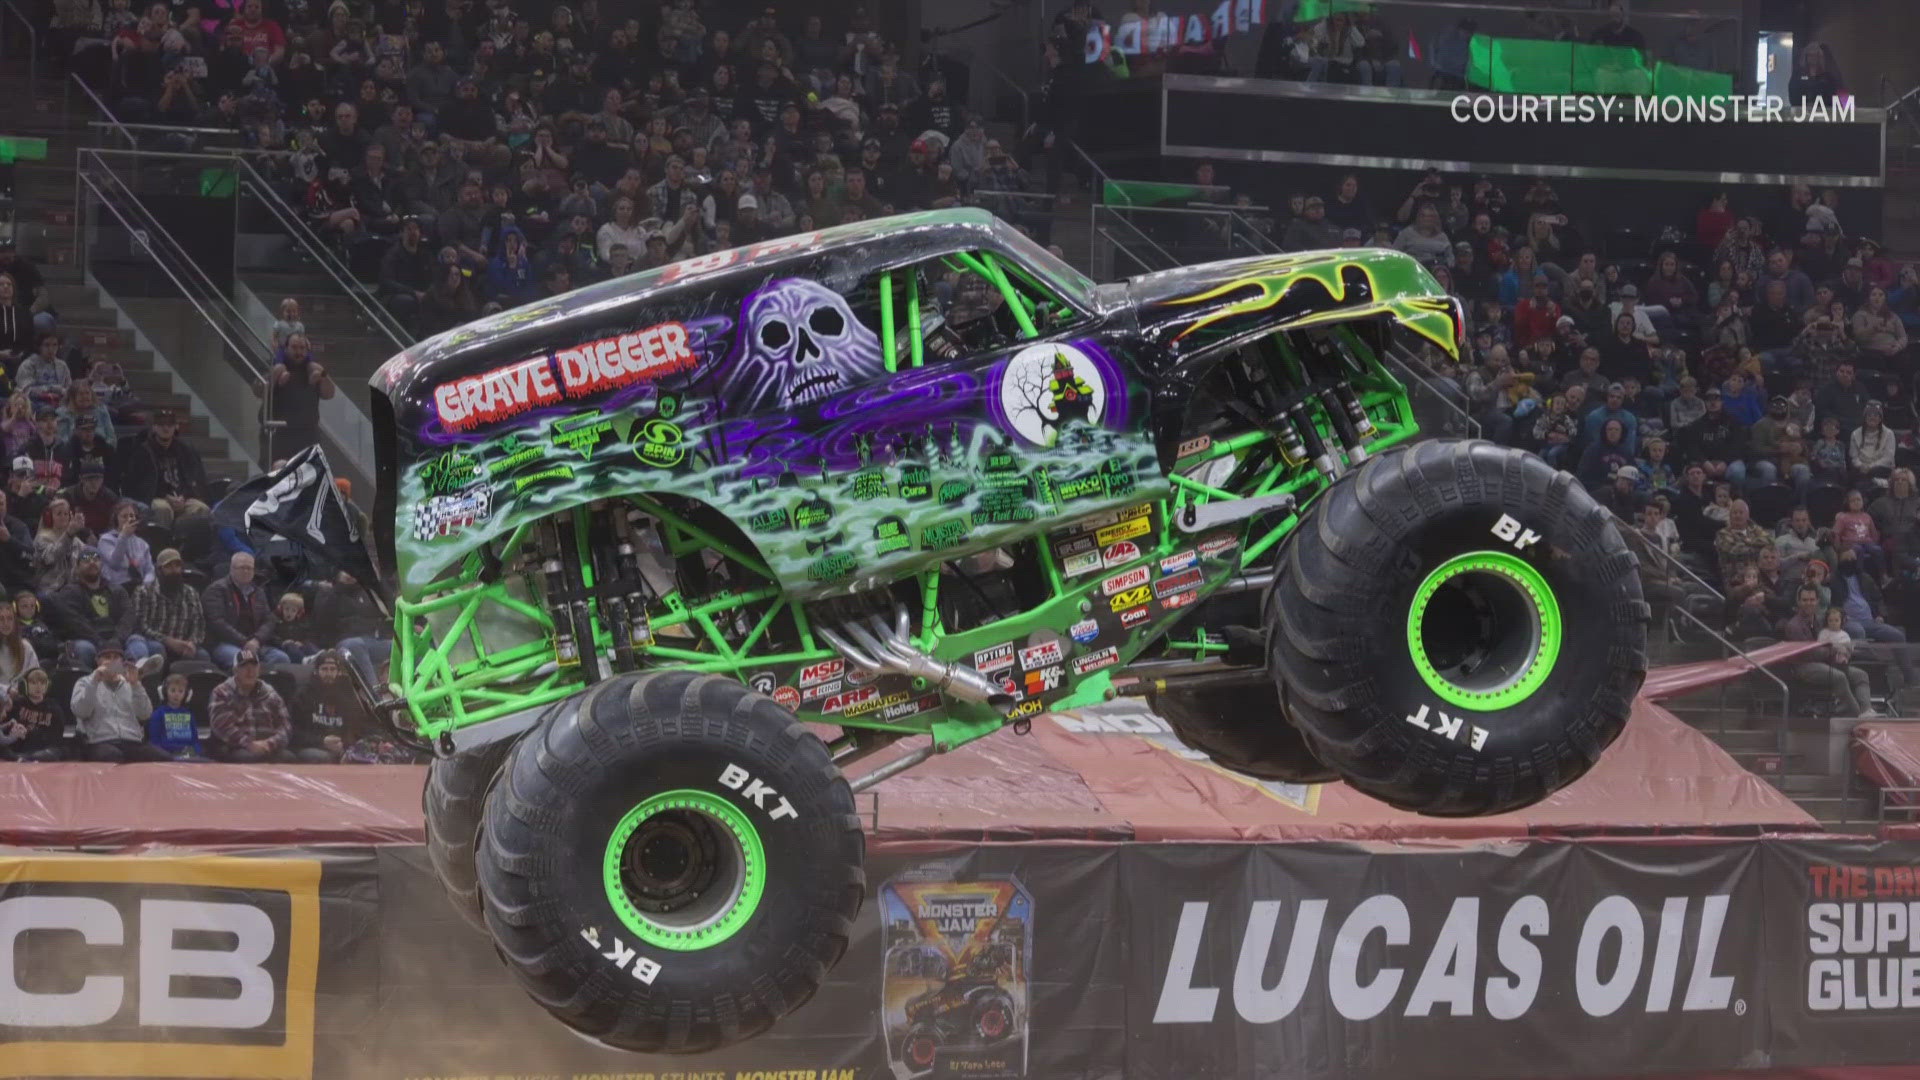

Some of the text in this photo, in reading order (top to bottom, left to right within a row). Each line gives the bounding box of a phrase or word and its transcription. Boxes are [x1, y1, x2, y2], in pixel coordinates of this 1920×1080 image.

[434, 324, 690, 424] GRAVE DIGGER
[644, 443, 677, 458] SPIN
[1059, 475, 1101, 493] MAX-D
[752, 507, 787, 531] ALIEN
[1100, 523, 1132, 539] ENERGY
[1104, 541, 1137, 561] JAZ
[1106, 568, 1146, 592] SIMPSON
[1120, 609, 1147, 624] Coan
[977, 645, 1012, 663] OPTIMA
[1074, 649, 1110, 668] LINCOLN
[801, 659, 845, 682] MSD
[822, 685, 879, 712] ARP
[844, 691, 909, 717] MAGNAFLOW
[886, 702, 920, 719] Holley
[717, 762, 799, 821] BKT
[1808, 865, 1868, 898] THE
[918, 903, 998, 919] MONSTER
[939, 918, 975, 933] JAM
[0, 896, 275, 1031] CB
[1154, 893, 1736, 1024] LUCAS OIL
[1808, 957, 1920, 1010] GLUE
